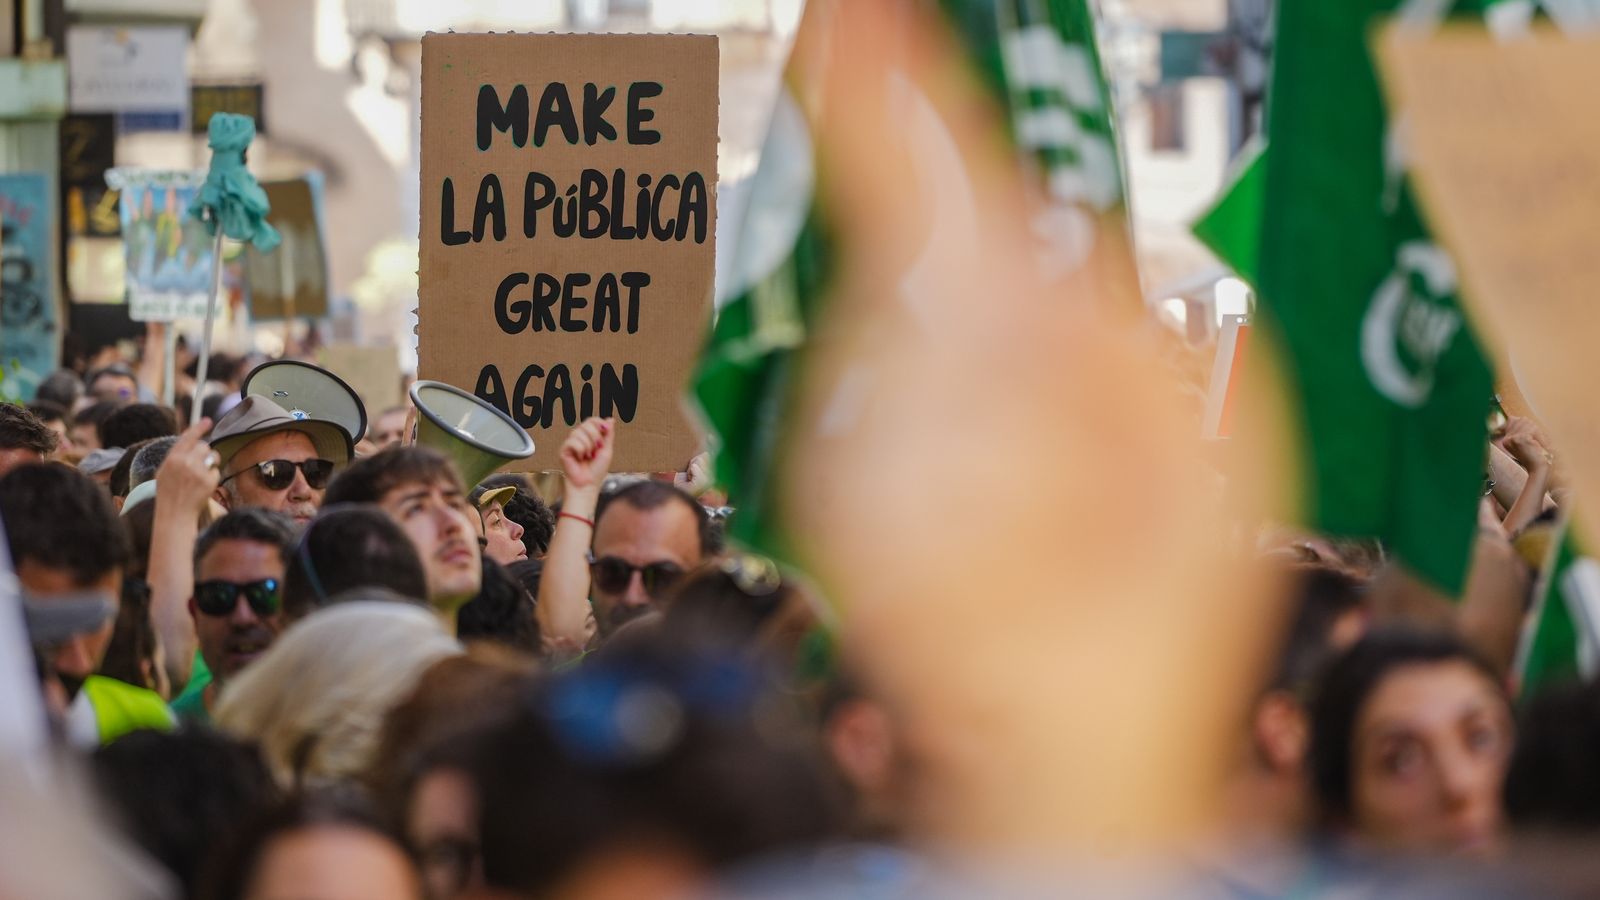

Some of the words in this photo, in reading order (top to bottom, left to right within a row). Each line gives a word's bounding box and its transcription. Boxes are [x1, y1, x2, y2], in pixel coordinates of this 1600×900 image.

[477, 82, 662, 150] MAKE
[441, 174, 506, 245] LA
[494, 272, 650, 334] GREAT
